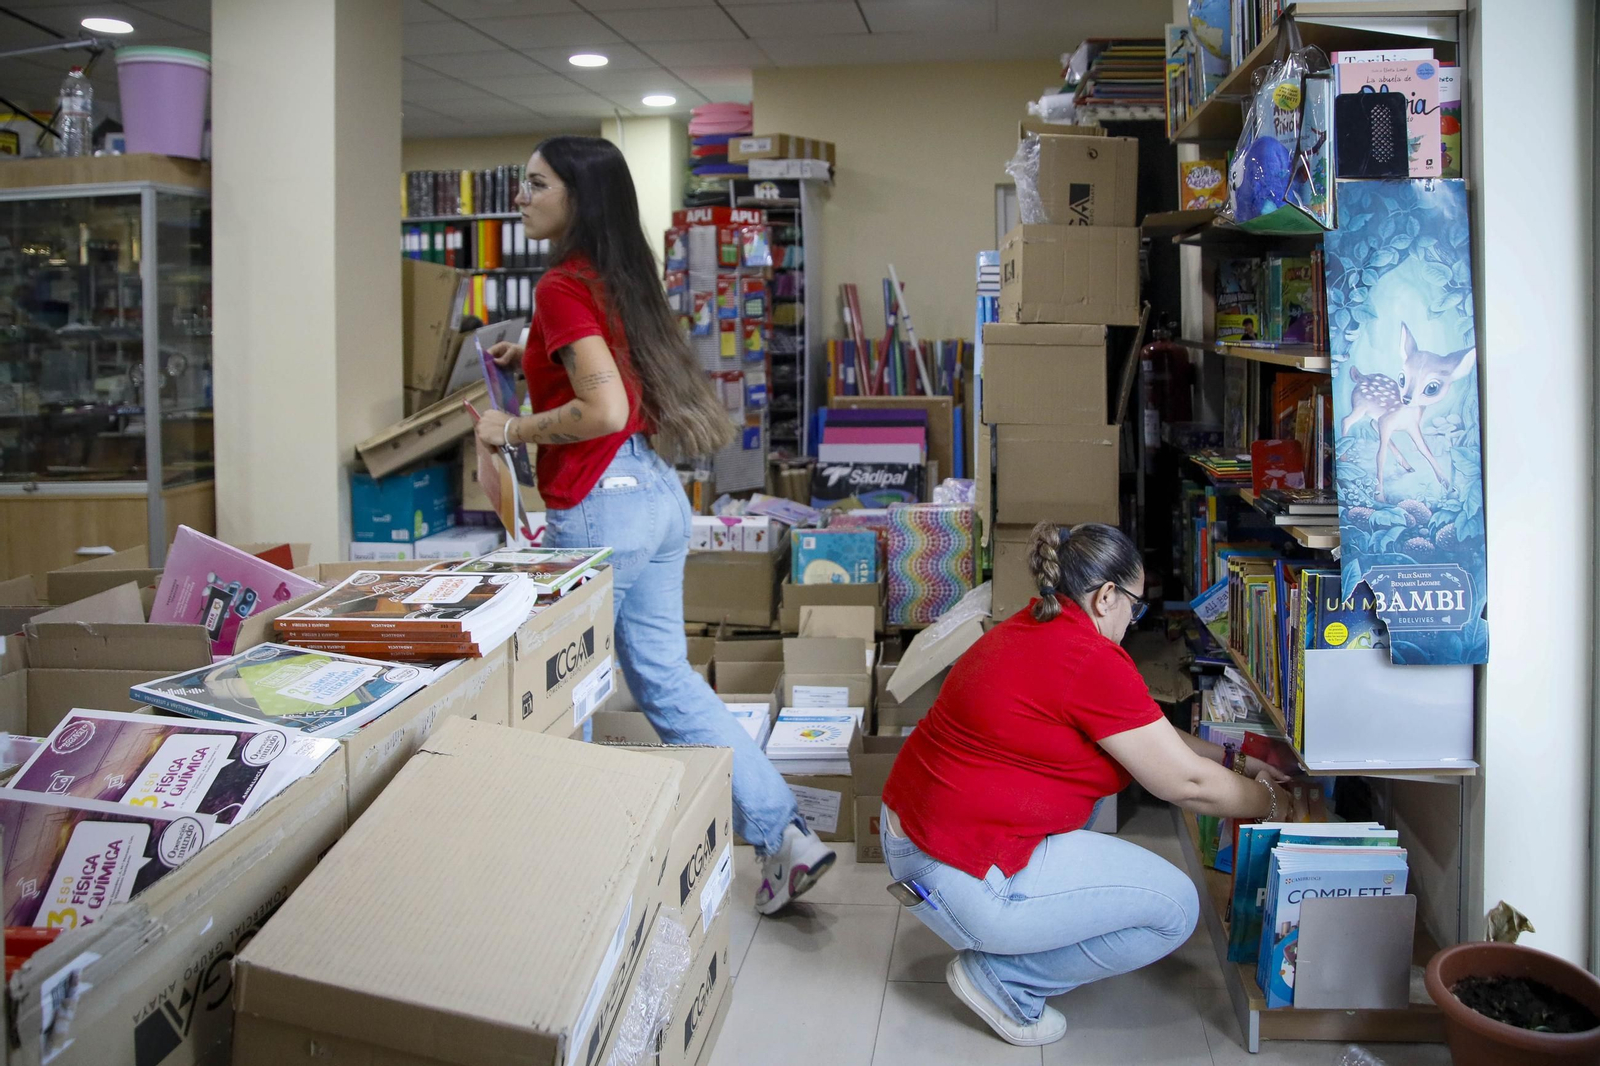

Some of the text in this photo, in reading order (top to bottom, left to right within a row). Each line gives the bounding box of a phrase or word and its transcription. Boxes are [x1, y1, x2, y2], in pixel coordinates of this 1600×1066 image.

[686, 208, 713, 223] APLI
[730, 209, 760, 224] APLI
[850, 469, 909, 485] Sadipal
[1391, 580, 1416, 588] BENJAMIN
[1205, 600, 1217, 614] Ali
[1326, 598, 1354, 611] UN
[1375, 590, 1465, 612] BAMBI
[557, 632, 588, 680] CGA
[287, 687, 312, 696] 2
[259, 735, 279, 761] mundo
[140, 772, 159, 793] ESO
[154, 757, 187, 794] FÍSICA
[161, 800, 175, 809] Y
[169, 745, 211, 797] QUÍMICA
[242, 767, 265, 799] ANDALUCÍA
[167, 822, 188, 859] Operación
[177, 824, 195, 859] mundo
[71, 854, 101, 905] FÍSICA
[80, 915, 94, 928] Y
[87, 839, 123, 910] QUÍMICA
[1291, 875, 1322, 884] CAMBRIDGE
[47, 876, 78, 930] 3 ESO
[131, 885, 288, 1024] COMERCIAL GRUPO ANAYA
